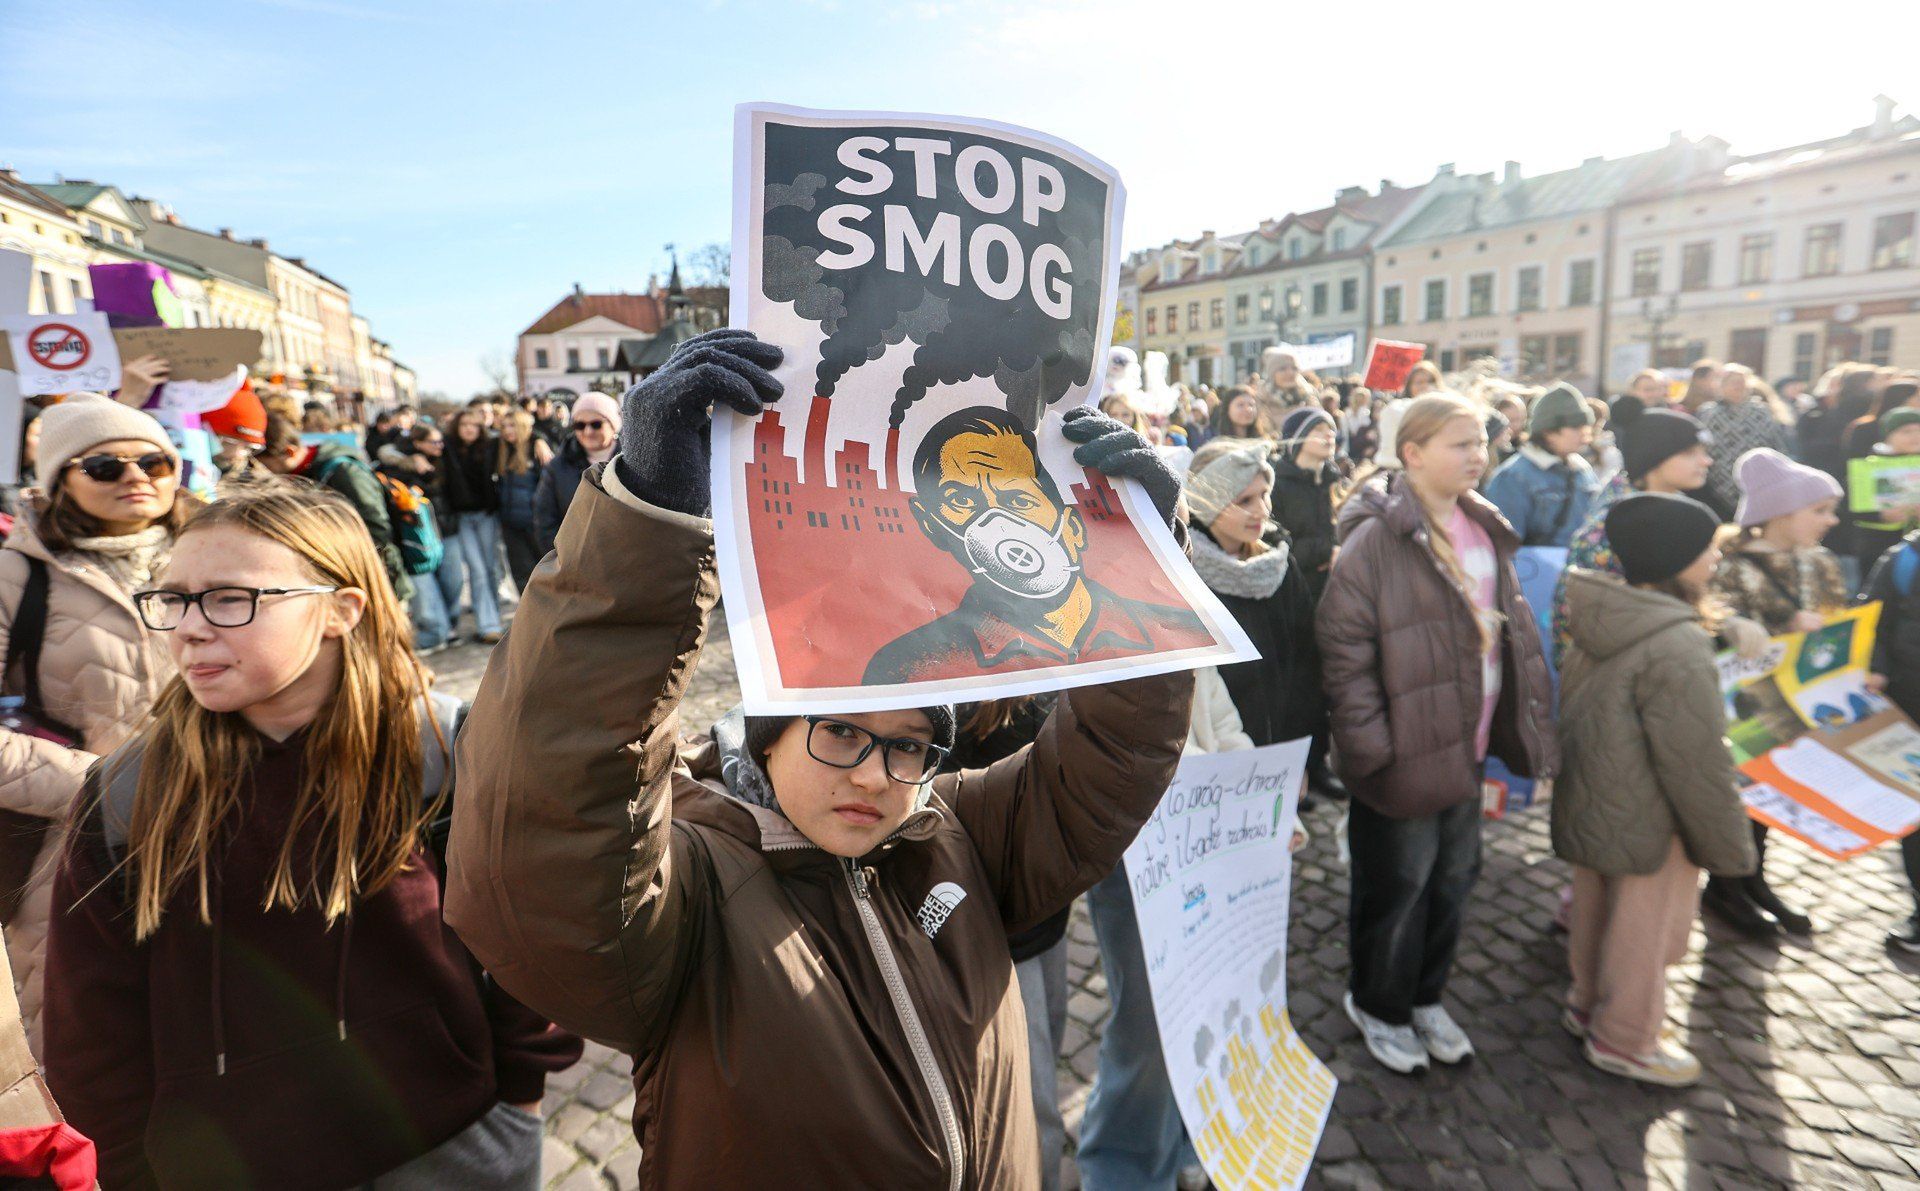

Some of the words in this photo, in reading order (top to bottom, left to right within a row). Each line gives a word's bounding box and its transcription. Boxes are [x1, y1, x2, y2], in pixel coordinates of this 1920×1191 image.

[834, 136, 1066, 227] STOP
[814, 203, 1073, 320] SMOG
[917, 894, 936, 918] THE
[925, 905, 952, 939] FACE
